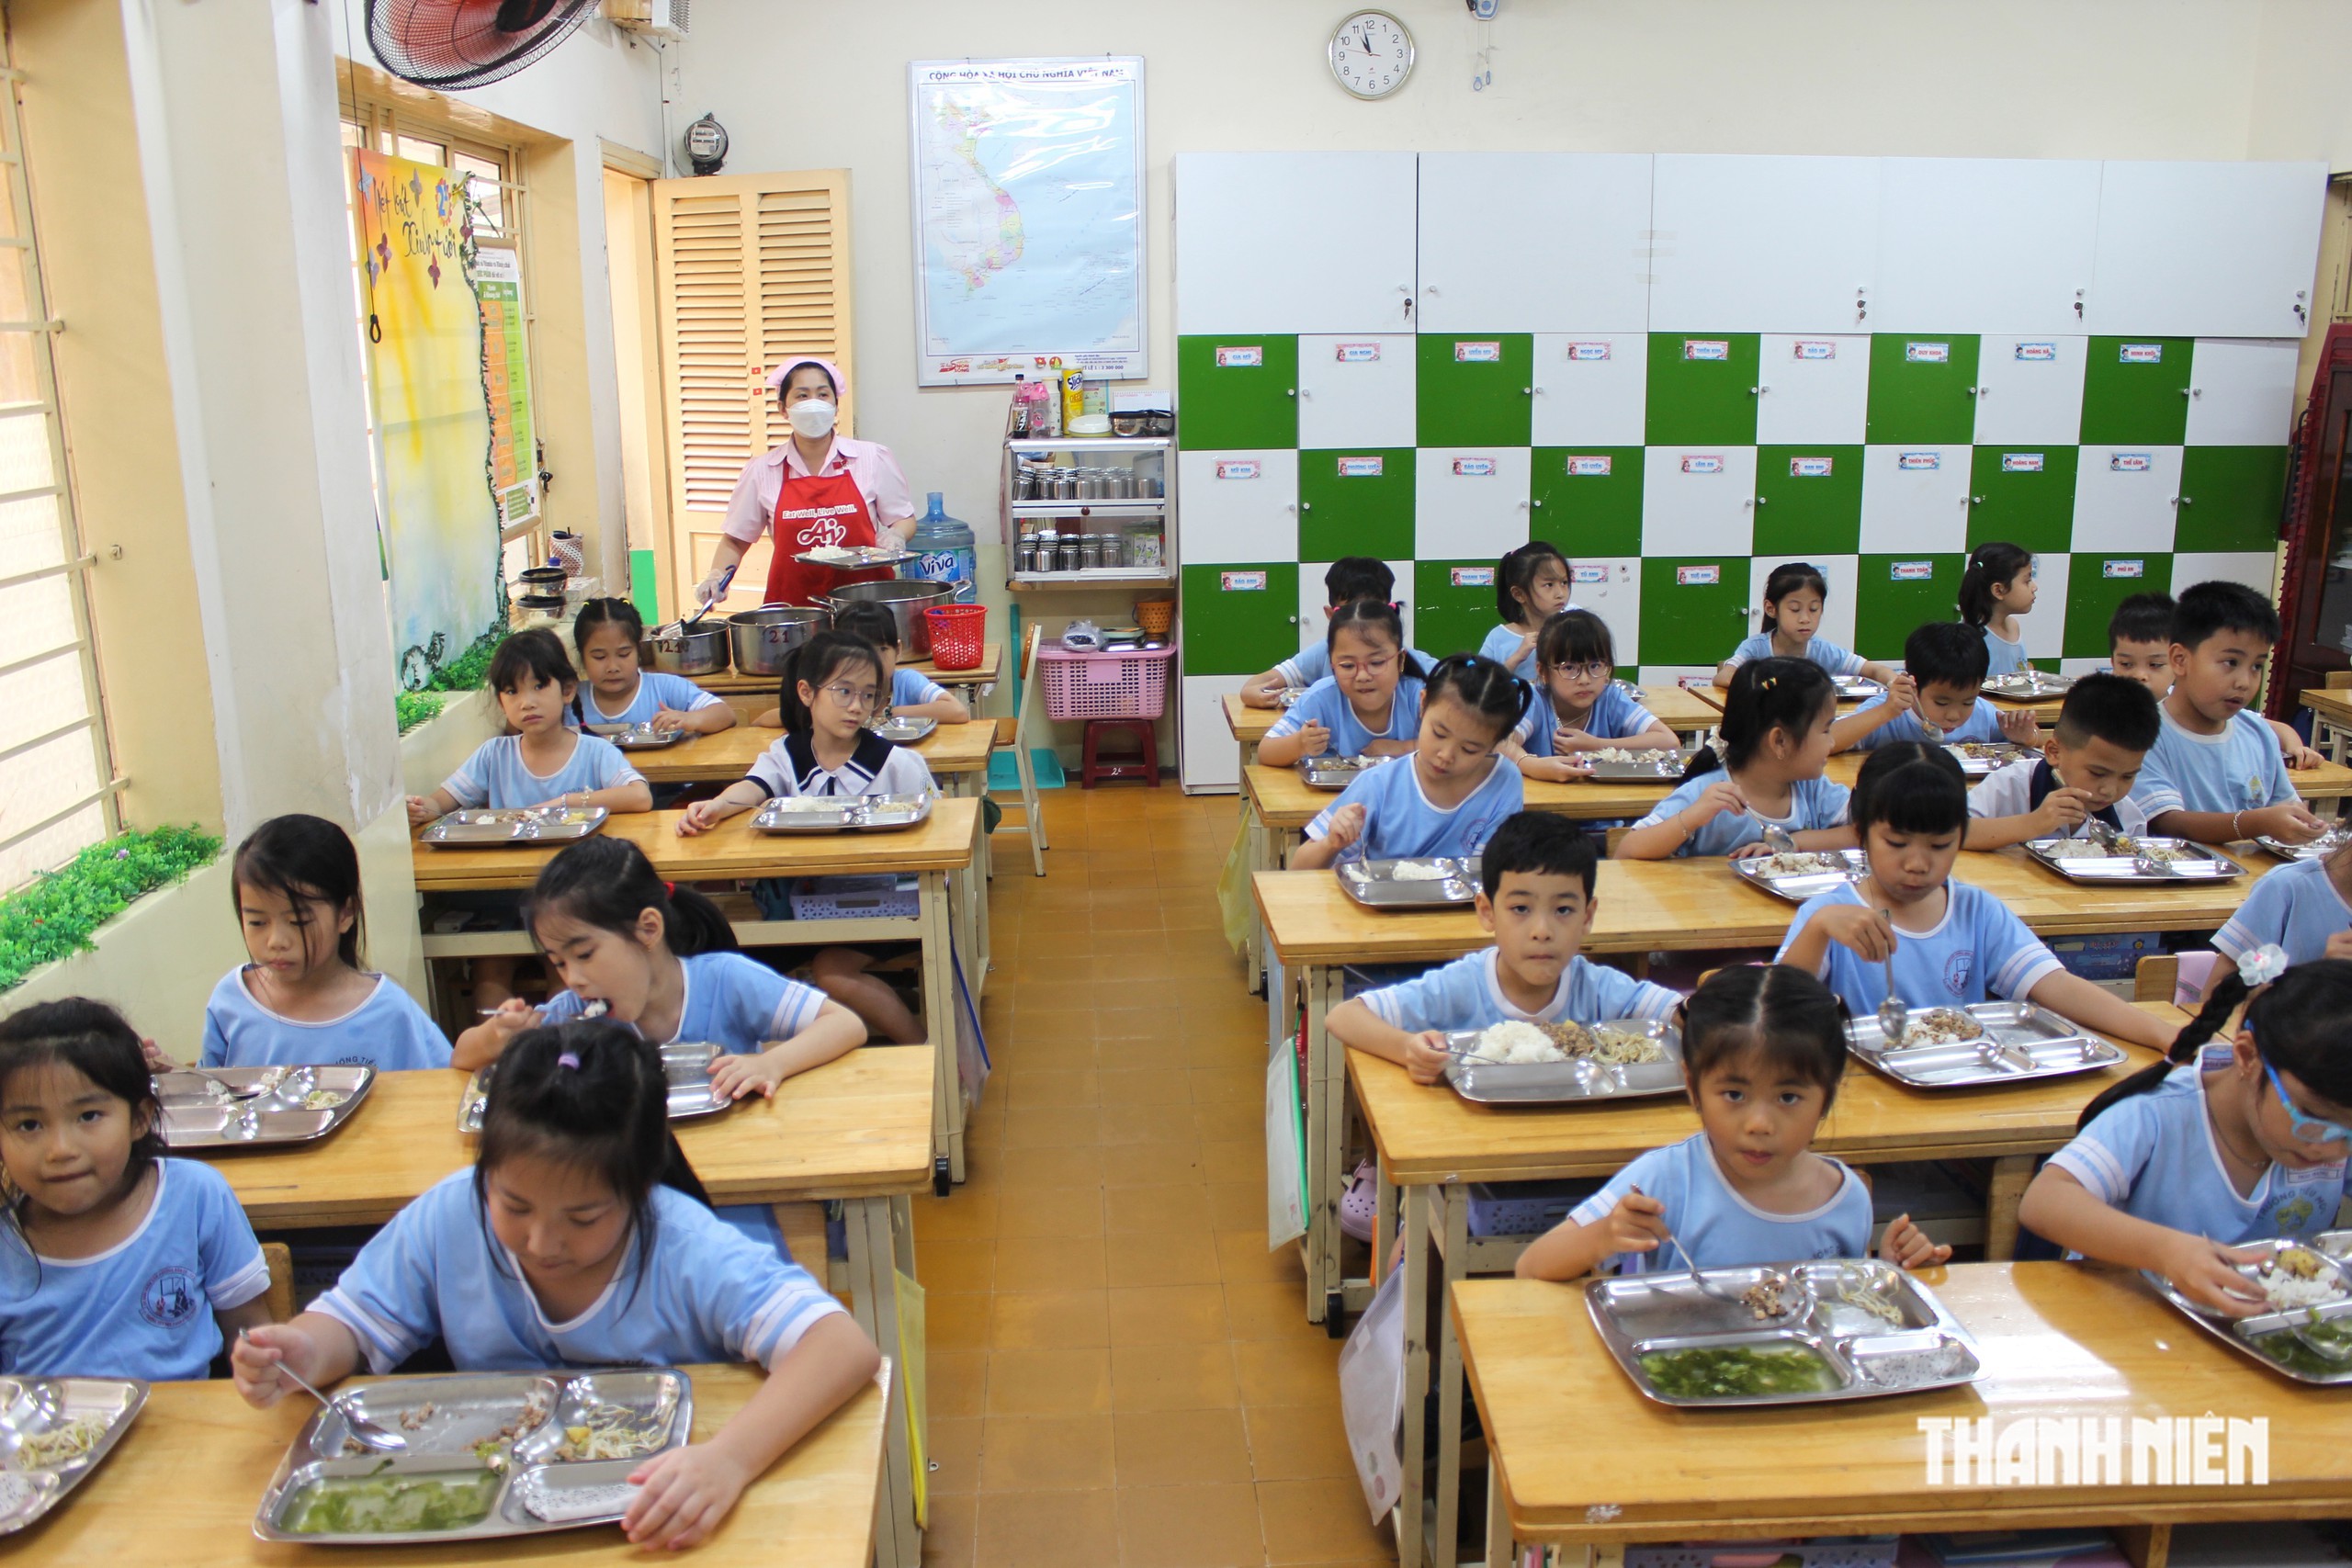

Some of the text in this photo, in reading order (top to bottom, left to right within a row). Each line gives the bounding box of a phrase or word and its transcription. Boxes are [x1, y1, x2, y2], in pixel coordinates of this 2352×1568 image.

[1364, 19, 1375, 29] 12
[1383, 23, 1387, 33] 1
[1352, 25, 1359, 34] 11
[1340, 36, 1351, 46] 10
[1392, 34, 1399, 43] 2
[1339, 51, 1345, 61] 9
[1396, 49, 1403, 59] 3
[1343, 66, 1350, 75] 8
[1394, 64, 1400, 73] 4
[1354, 76, 1361, 85] 7
[1369, 80, 1375, 89] 6
[1384, 75, 1390, 85] 5
[782, 511, 797, 519] Eat
[817, 507, 835, 516] Live
[920, 557, 954, 575] Viva
[769, 630, 789, 643] 21
